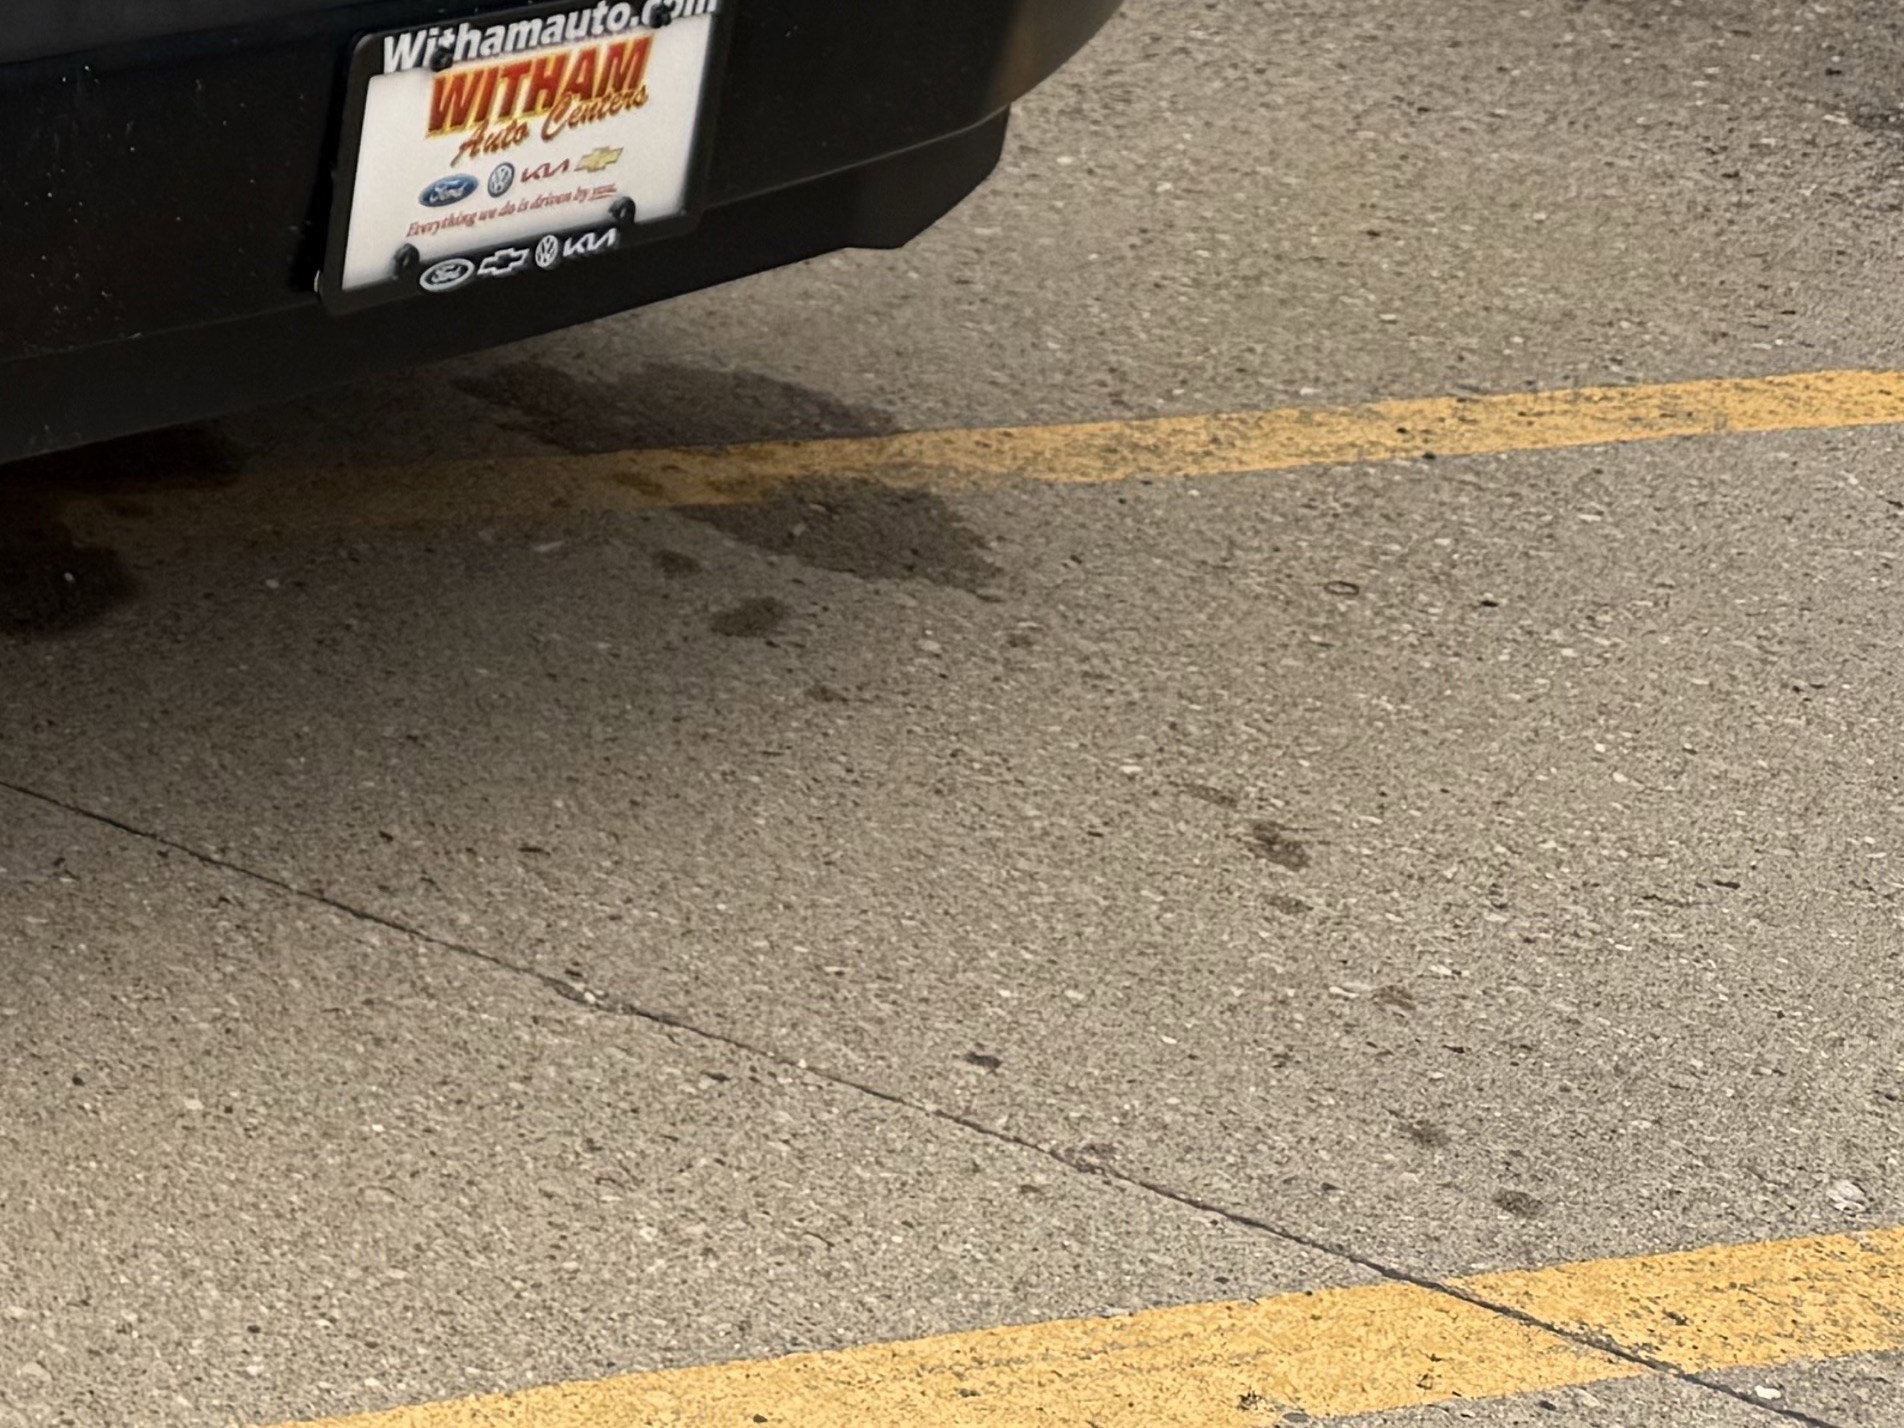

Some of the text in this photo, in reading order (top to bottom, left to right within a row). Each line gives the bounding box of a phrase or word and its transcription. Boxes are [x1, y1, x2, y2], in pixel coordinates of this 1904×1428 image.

[426, 34, 655, 134] WITHAM
[450, 84, 649, 168] Auto Centers
[406, 209, 478, 238] Everything
[478, 207, 496, 221] we
[498, 200, 517, 218] do
[517, 198, 529, 213] is
[530, 190, 572, 210] driven
[574, 186, 589, 203] by
[426, 178, 471, 204] Ford
